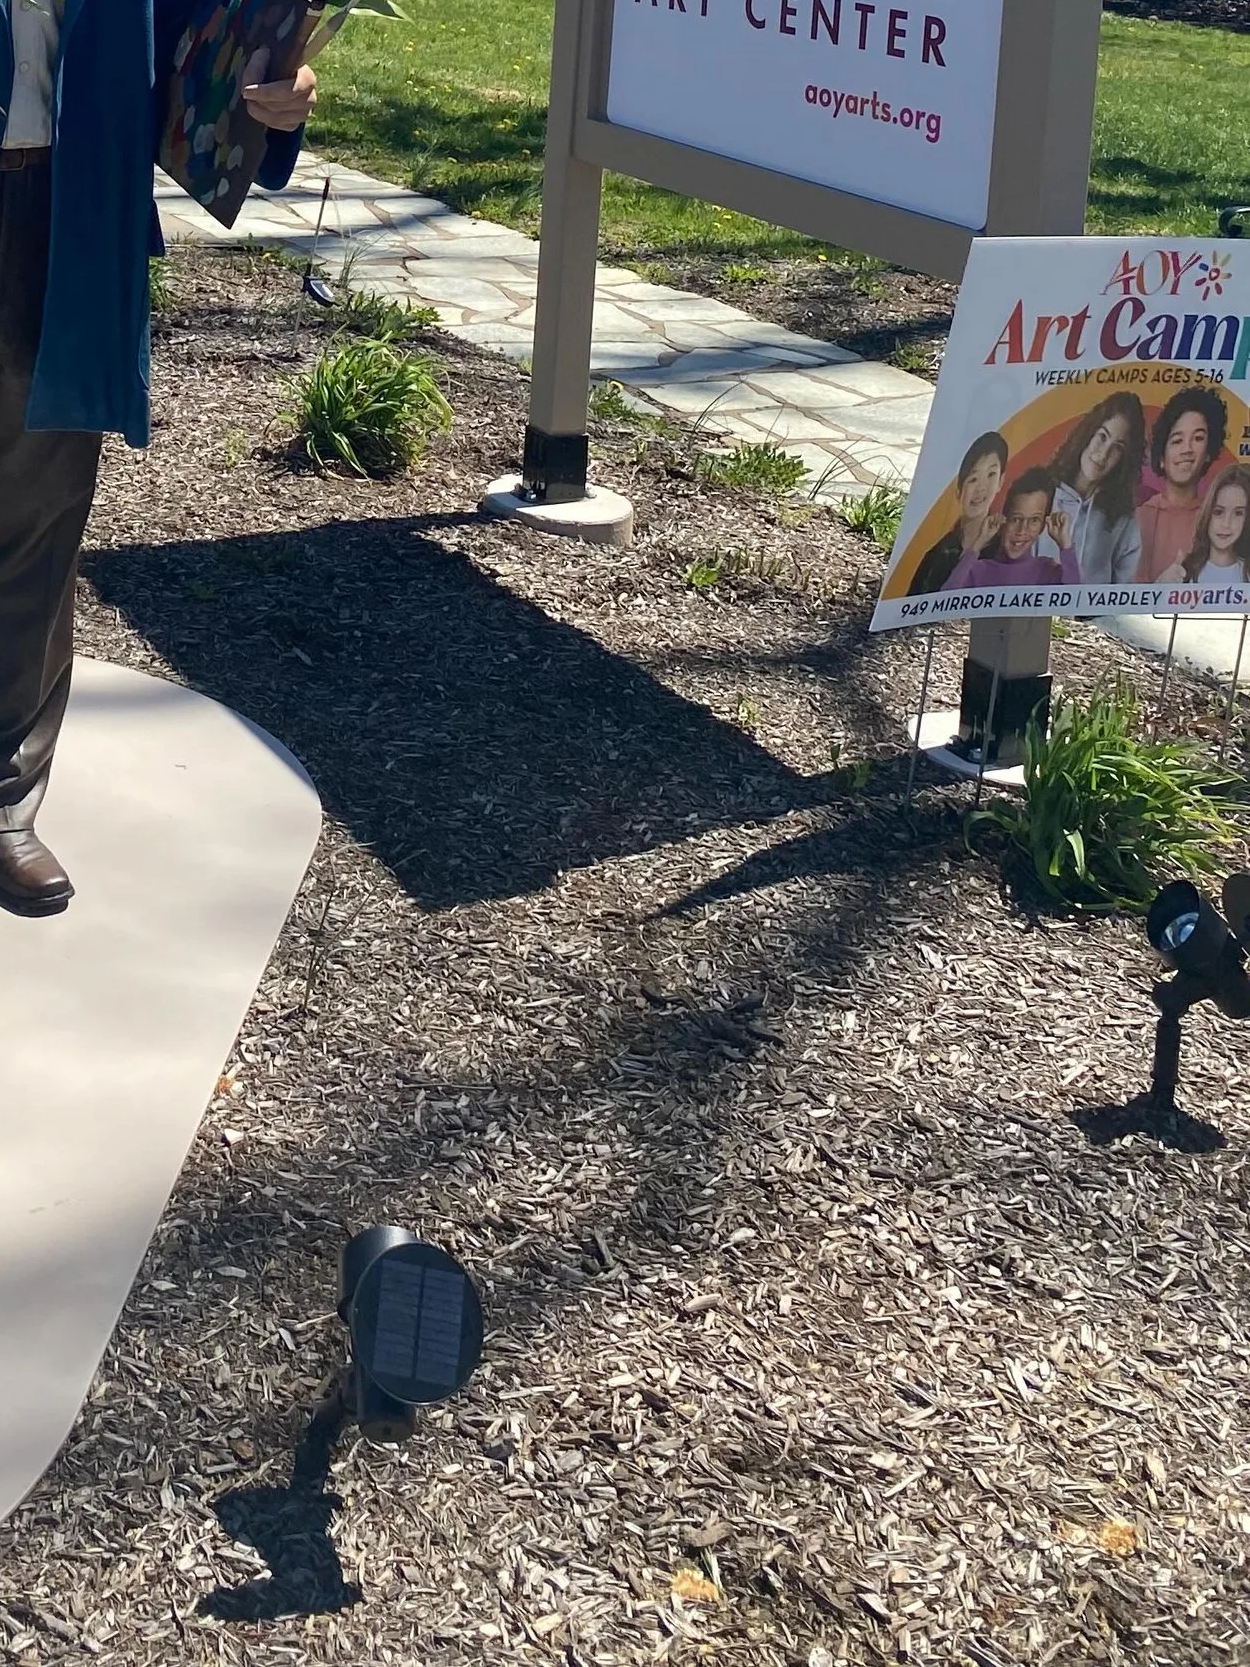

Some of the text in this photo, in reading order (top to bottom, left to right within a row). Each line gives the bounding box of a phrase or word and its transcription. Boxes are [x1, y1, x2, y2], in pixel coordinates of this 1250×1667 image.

[804, 84, 941, 143] aoyarts.org
[1099, 249, 1202, 296] AOY
[983, 298, 1091, 365] Art
[1035, 368, 1223, 385] WEEKLY CAMPS AGES 5-16
[901, 600, 928, 618] 949
[931, 594, 995, 613] MIRROR
[999, 592, 1044, 608] LAKE
[1049, 592, 1072, 607] RD
[1087, 590, 1163, 606] YARDLEY
